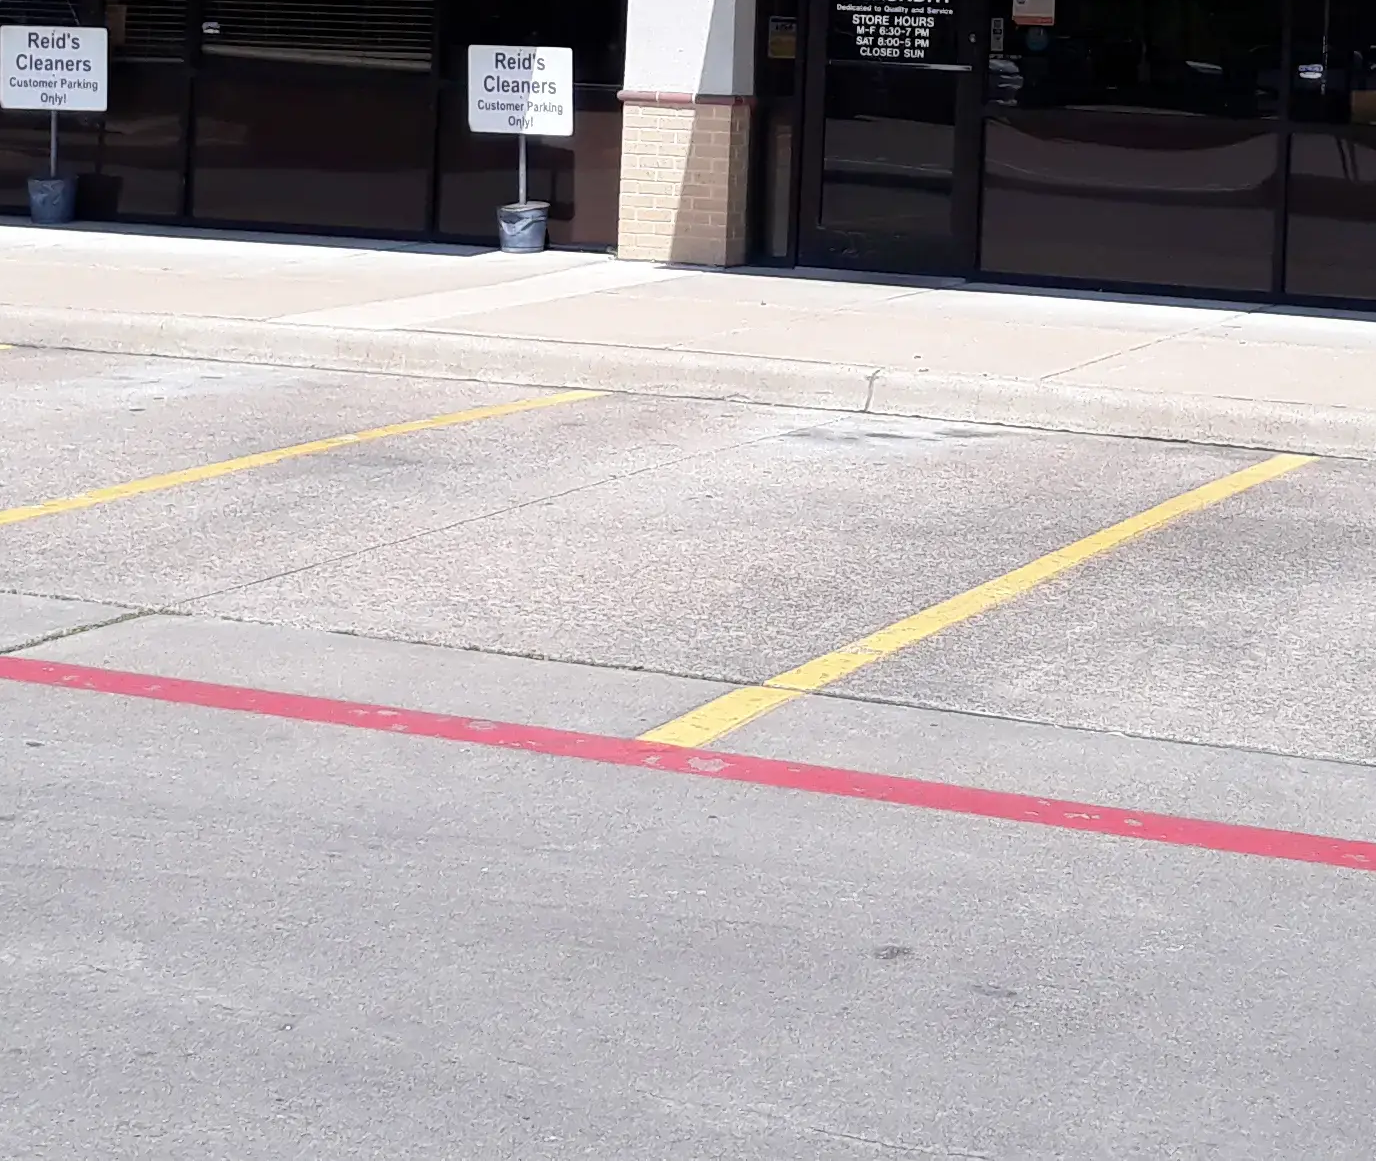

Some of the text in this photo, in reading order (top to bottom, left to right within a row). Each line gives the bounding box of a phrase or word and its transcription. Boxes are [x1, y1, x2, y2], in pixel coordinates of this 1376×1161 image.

[837, 4, 872, 12] Dedicated
[884, 6, 909, 14] Quality
[927, 7, 953, 15] Service
[852, 14, 934, 27] STORE HOURS
[856, 26, 929, 37] M-F 6:30-7 PM
[27, 32, 80, 49] Reid's
[856, 36, 929, 47] SAT 8:00-5 PM
[860, 47, 924, 58] CLOSED SUN
[16, 53, 92, 72] Cleaners
[494, 52, 545, 71] Reid's
[9, 77, 98, 92] Customer Parking
[483, 75, 557, 94] Cleaners
[40, 92, 66, 105] Only!
[477, 99, 563, 115] Customer Parking
[508, 116, 533, 130] Only!
